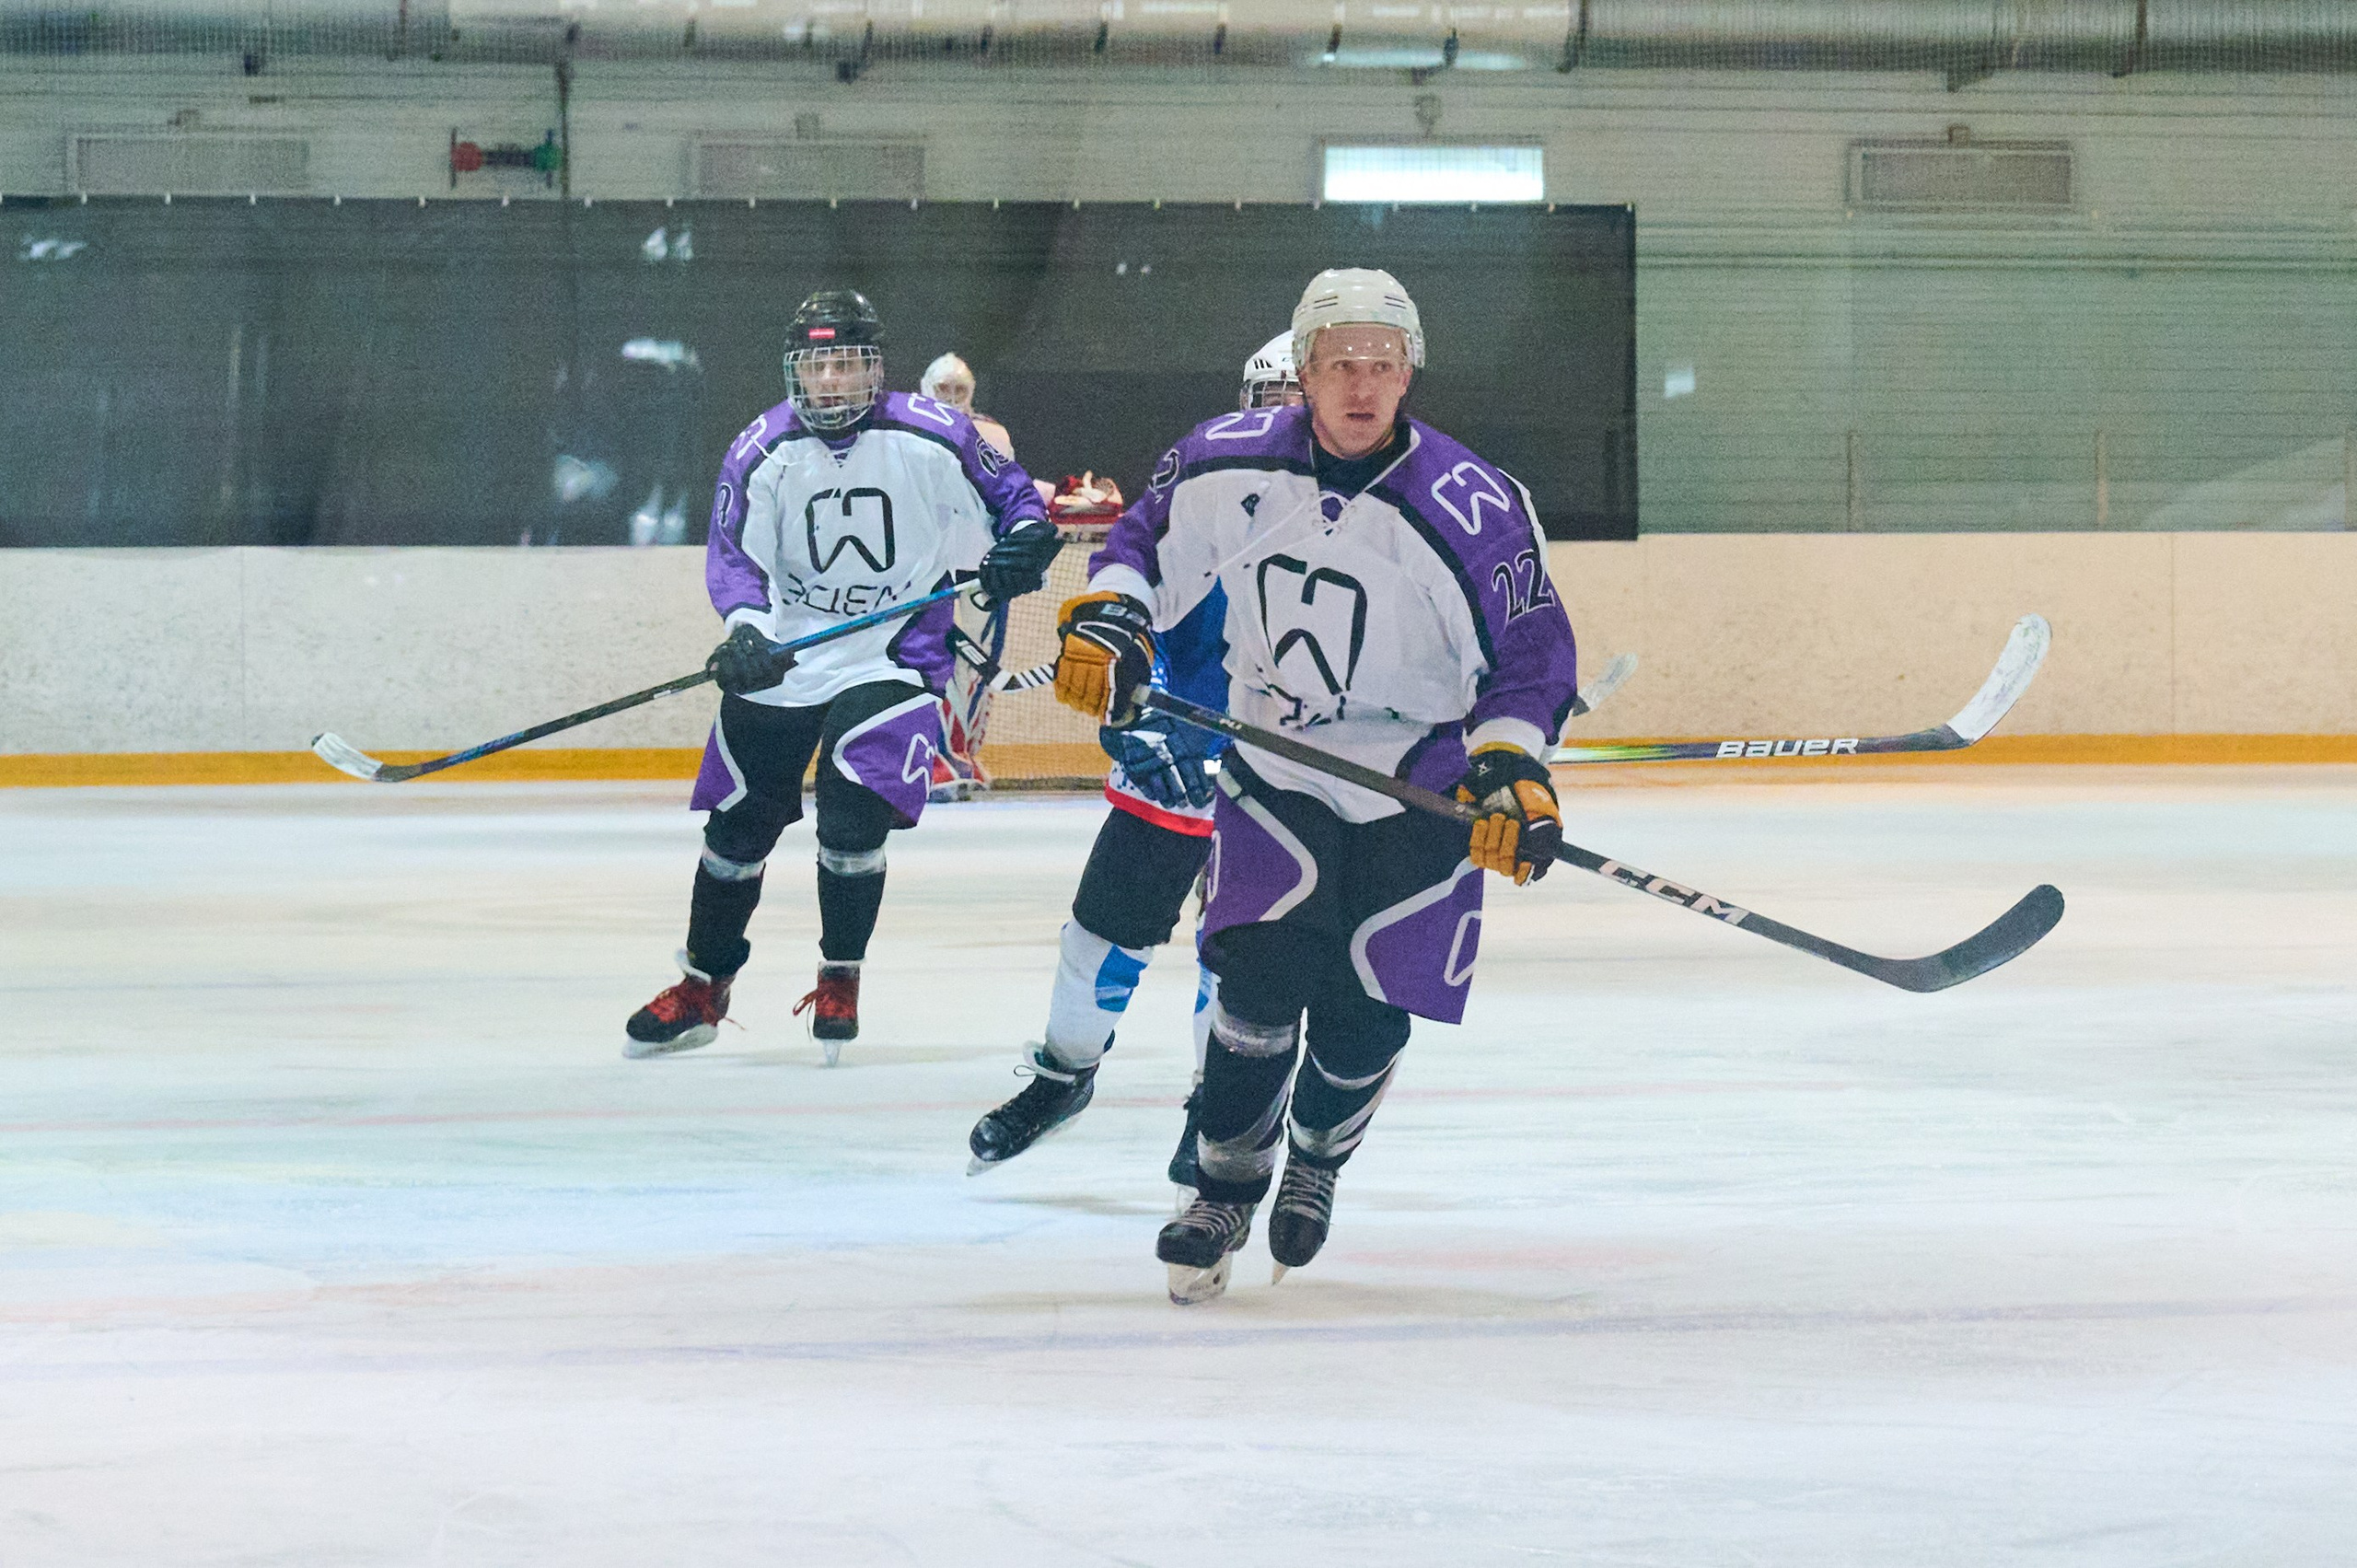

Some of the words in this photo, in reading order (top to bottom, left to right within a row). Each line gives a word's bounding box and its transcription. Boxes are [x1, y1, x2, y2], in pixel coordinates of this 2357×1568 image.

[1492, 549, 1555, 631] 22
[1715, 738, 1859, 759] BAUER
[1598, 860, 1749, 926] CCM
